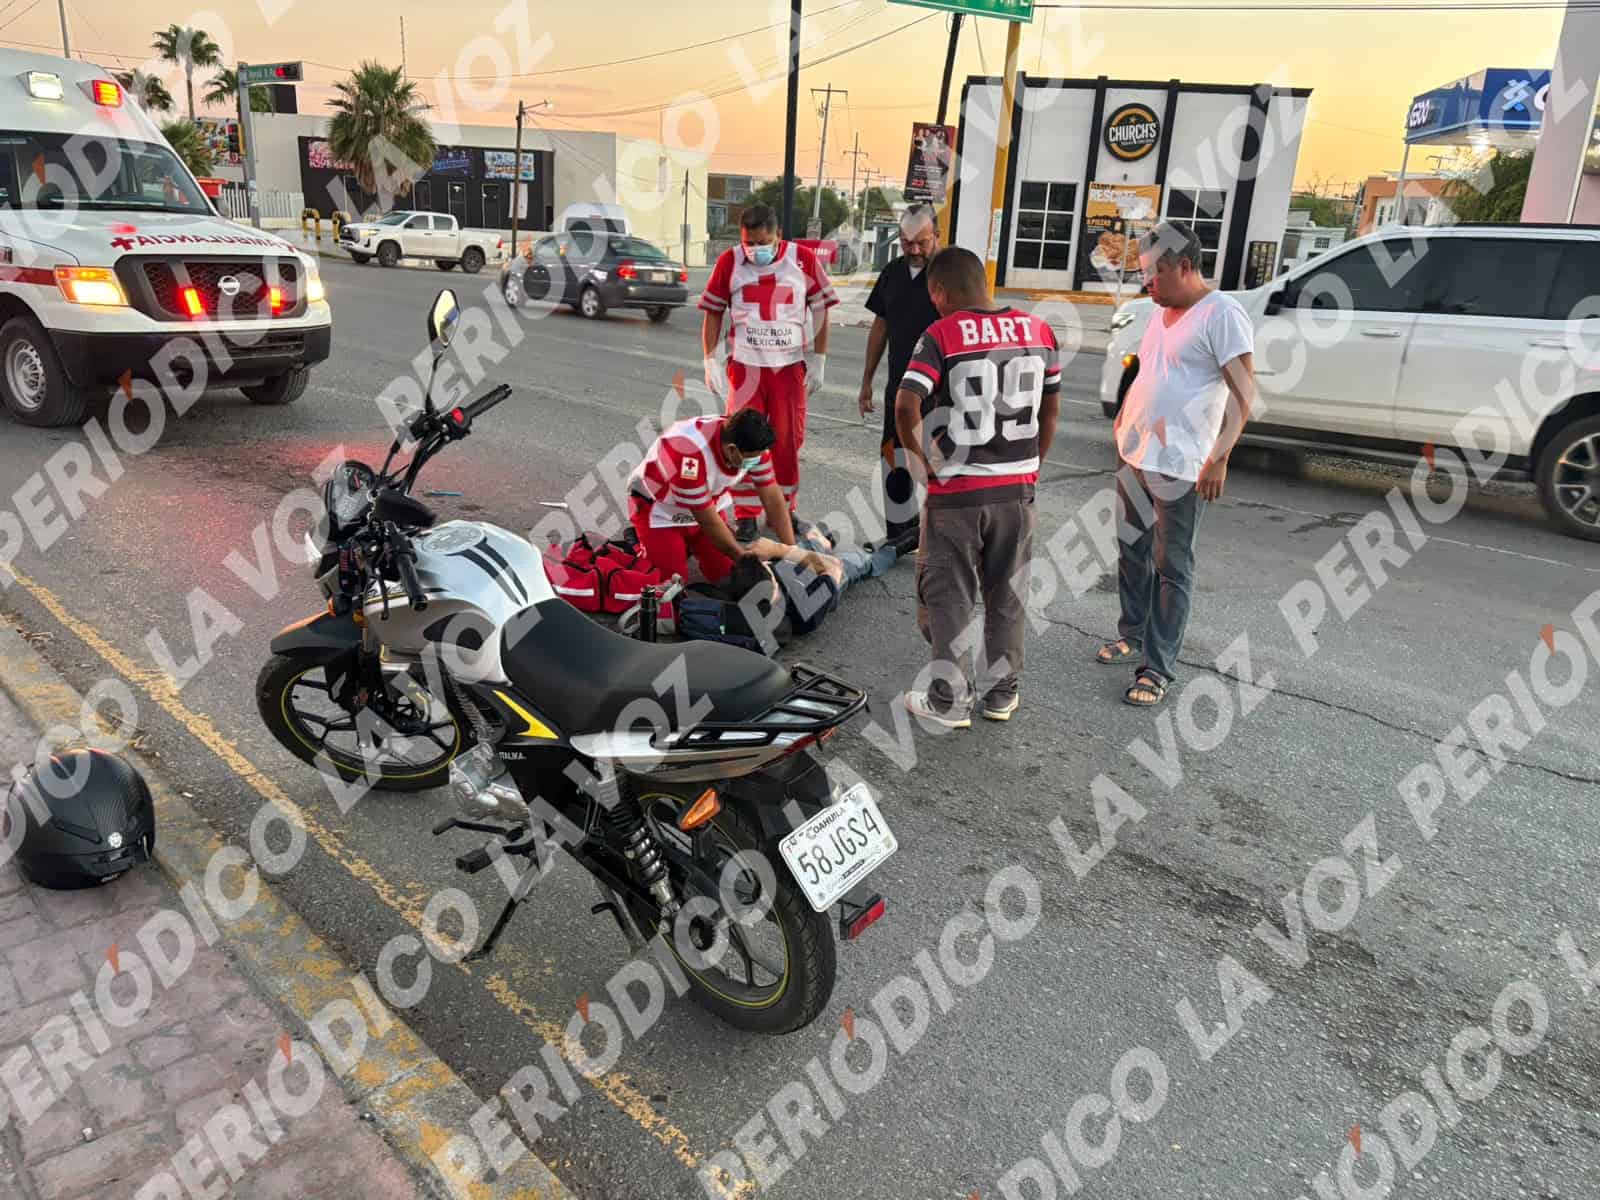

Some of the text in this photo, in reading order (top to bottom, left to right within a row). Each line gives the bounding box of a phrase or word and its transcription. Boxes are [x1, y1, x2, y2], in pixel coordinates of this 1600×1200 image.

[1109, 122, 1157, 144] CHURCH'S
[746, 327, 793, 336] CRUZ ROJA
[746, 336, 793, 346] MEXICANA
[958, 315, 1034, 347] BART
[948, 354, 1047, 448] 89
[806, 807, 846, 840] COAHUILA
[798, 807, 881, 885] 58JGS4
